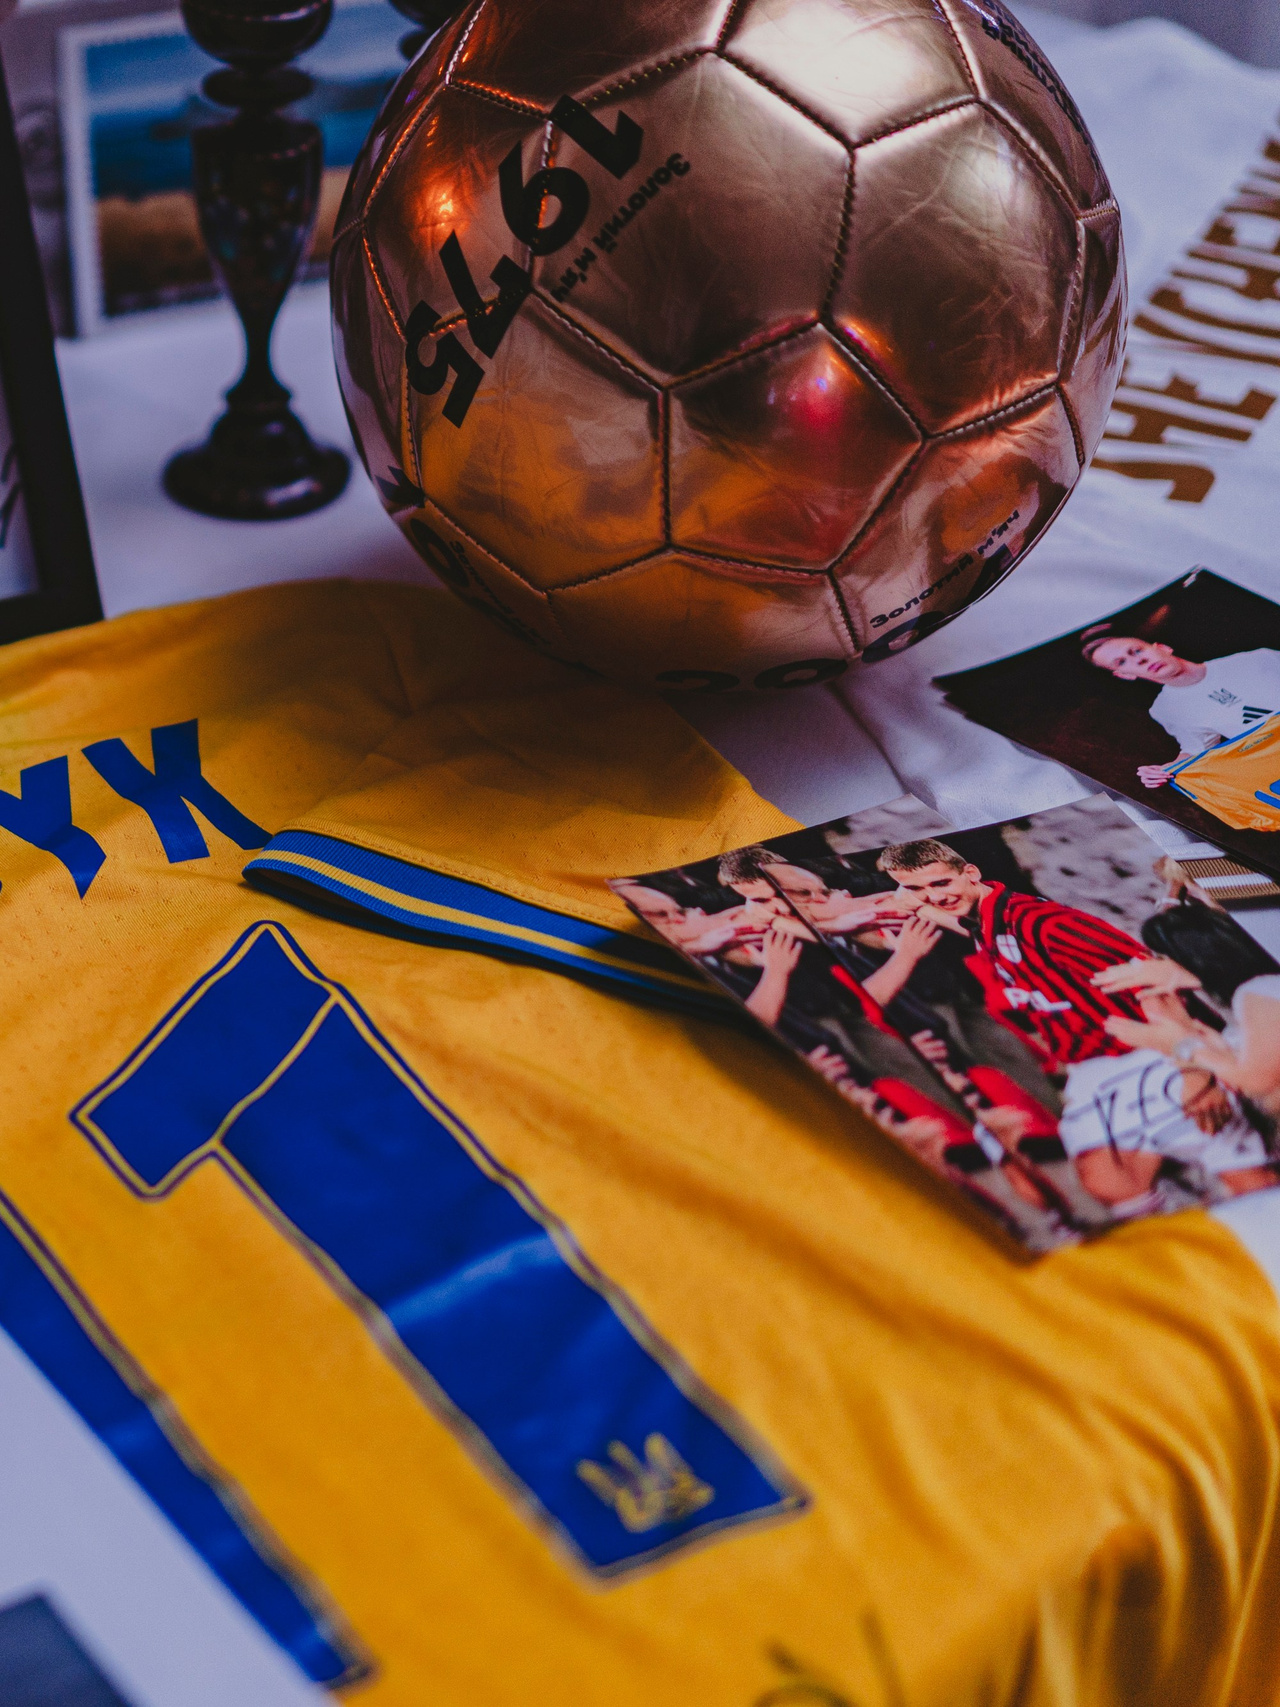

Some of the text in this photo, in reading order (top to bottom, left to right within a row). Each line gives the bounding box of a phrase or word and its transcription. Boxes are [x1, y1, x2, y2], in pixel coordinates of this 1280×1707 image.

[593, 153, 691, 254] Золотий
[404, 94, 644, 429] 1975
[869, 552, 974, 629] Золотий
